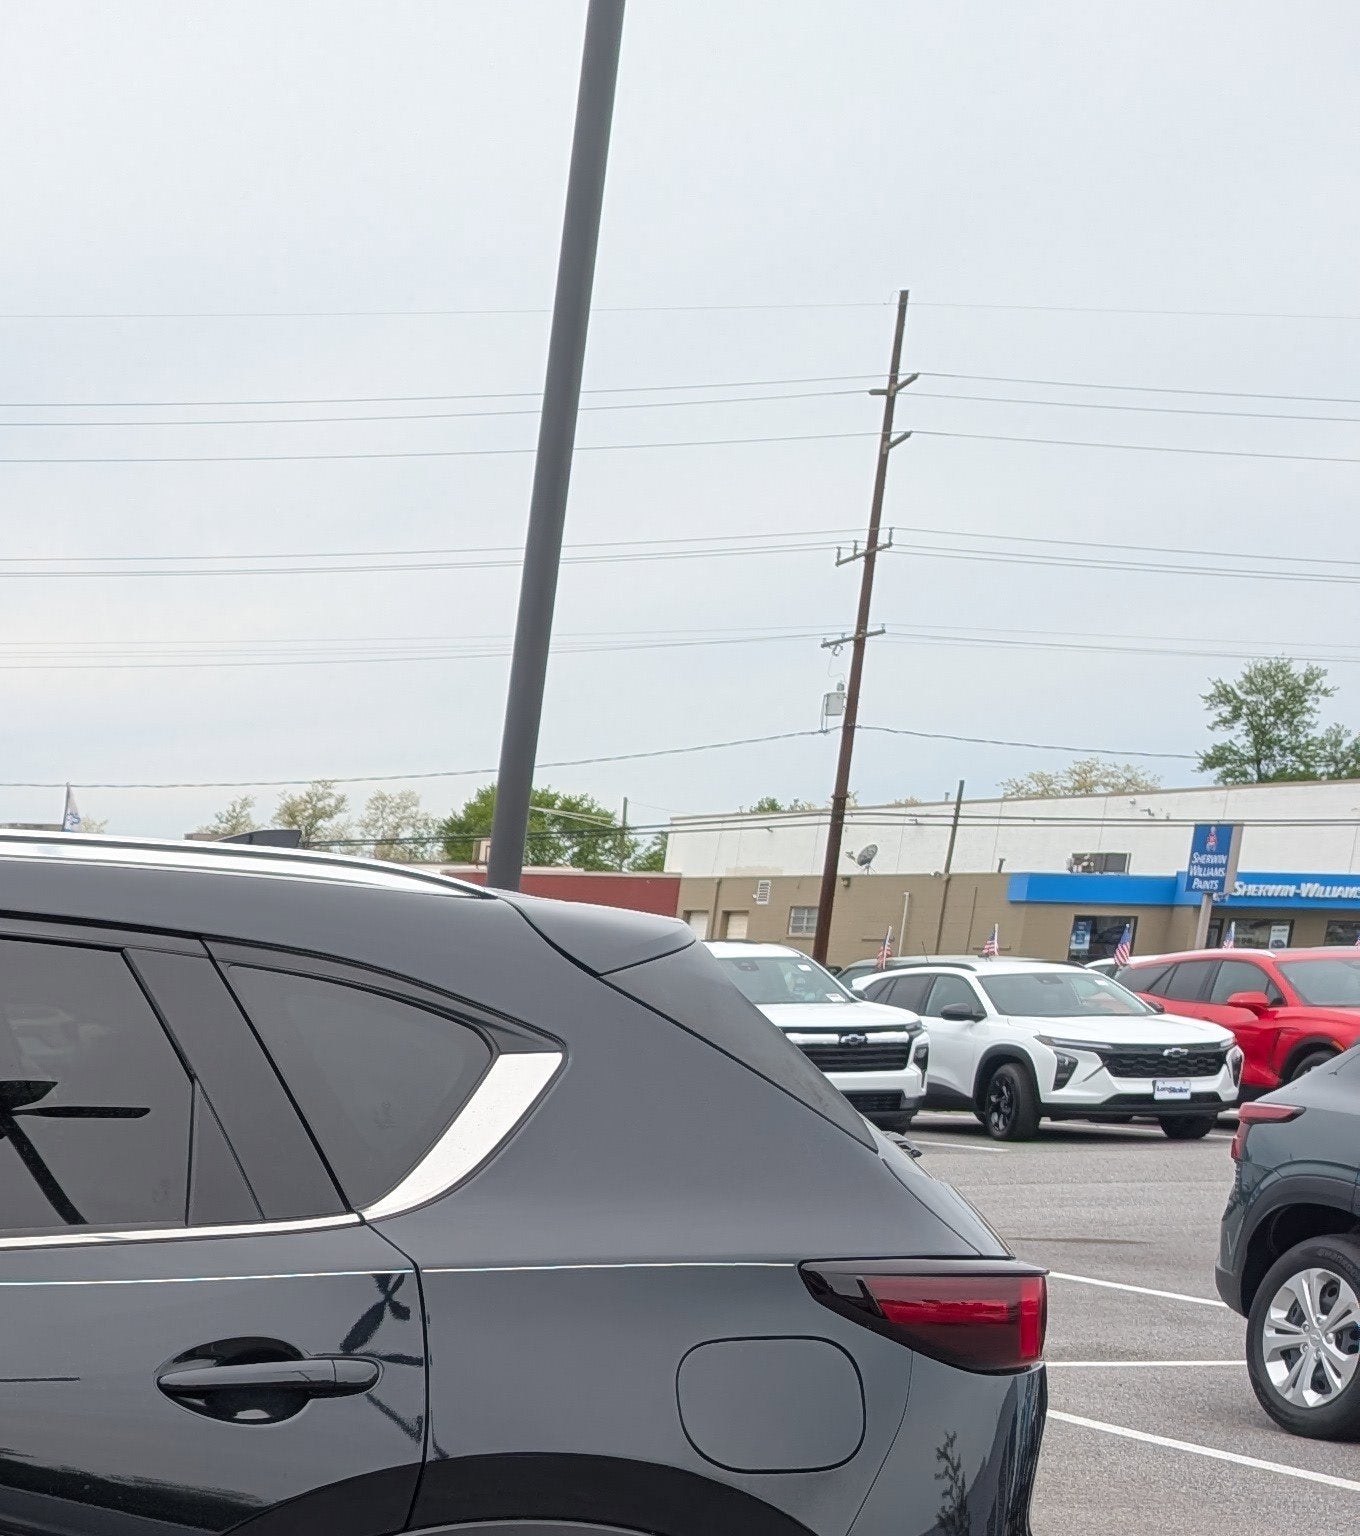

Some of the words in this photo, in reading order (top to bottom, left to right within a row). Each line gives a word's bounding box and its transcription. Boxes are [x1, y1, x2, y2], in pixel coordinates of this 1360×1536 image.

[1191, 852, 1228, 864] SHERWIN
[1190, 865, 1226, 877] WILLIAMS
[1191, 878, 1219, 890] PAINTS
